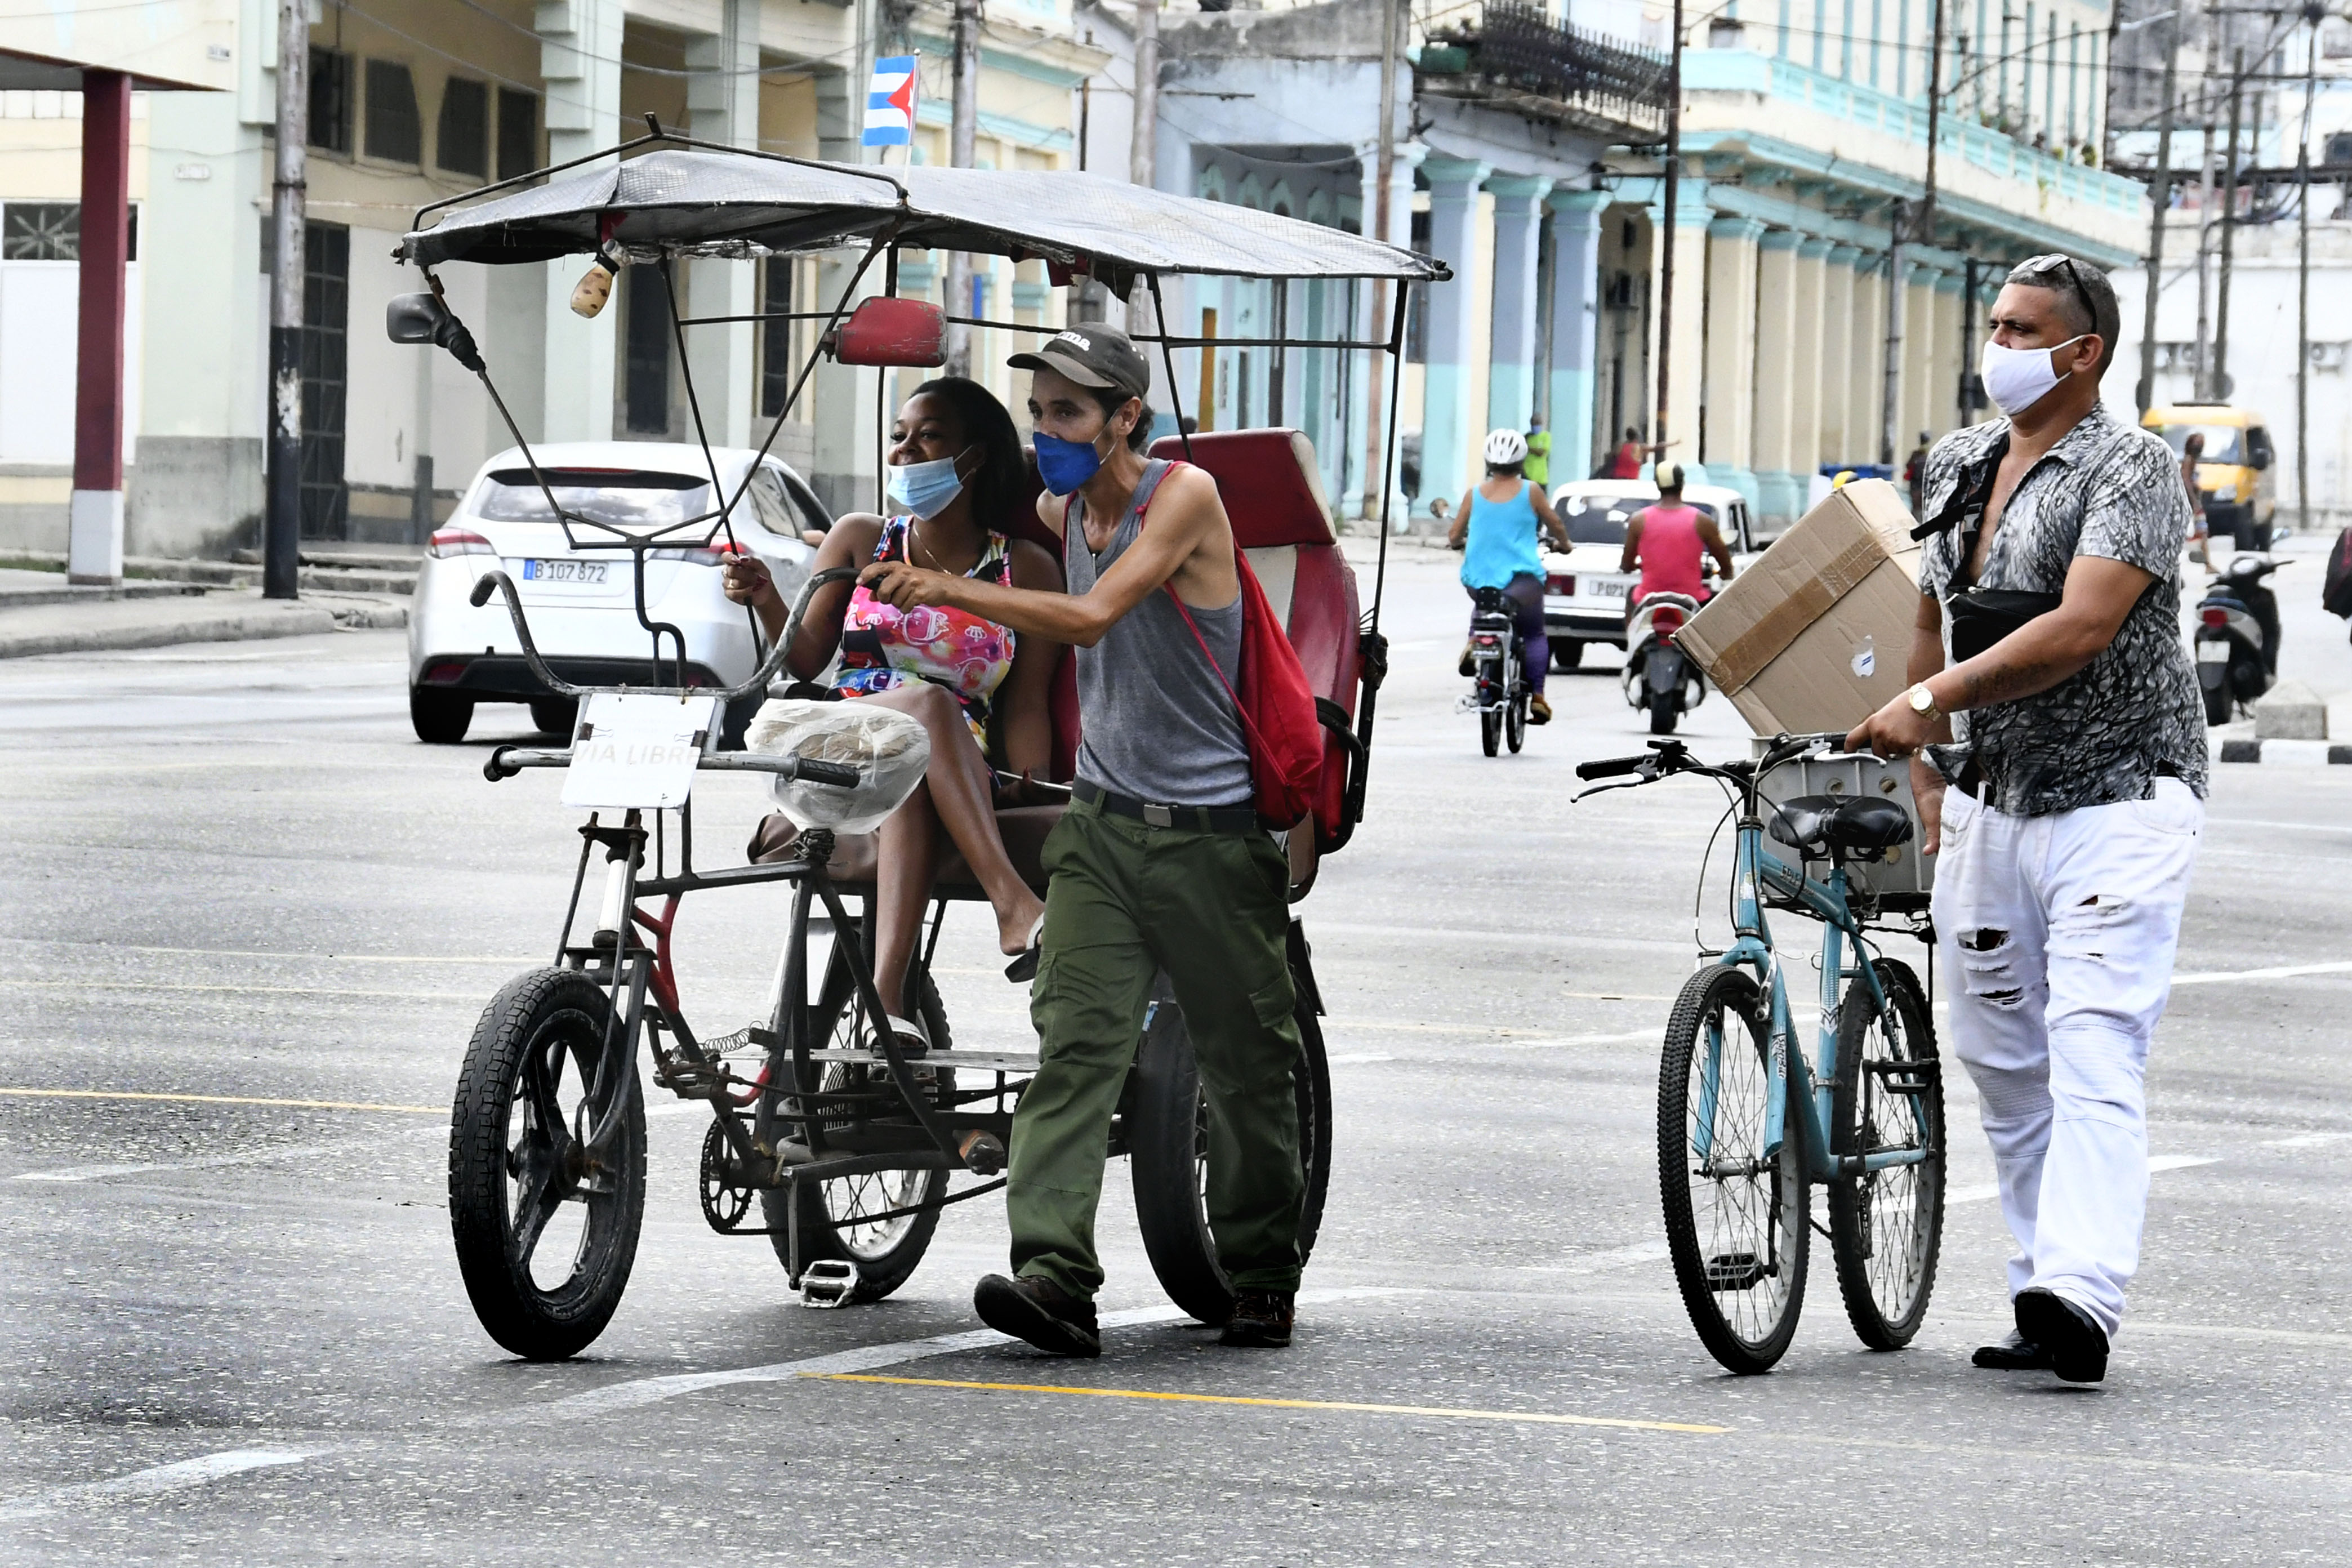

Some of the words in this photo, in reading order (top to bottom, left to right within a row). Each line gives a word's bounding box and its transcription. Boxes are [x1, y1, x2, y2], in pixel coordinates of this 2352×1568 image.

[534, 563, 544, 578] B
[547, 564, 574, 579] 107
[578, 565, 605, 581] 872
[575, 743, 616, 763] VIA
[626, 744, 700, 765] LIBRE
